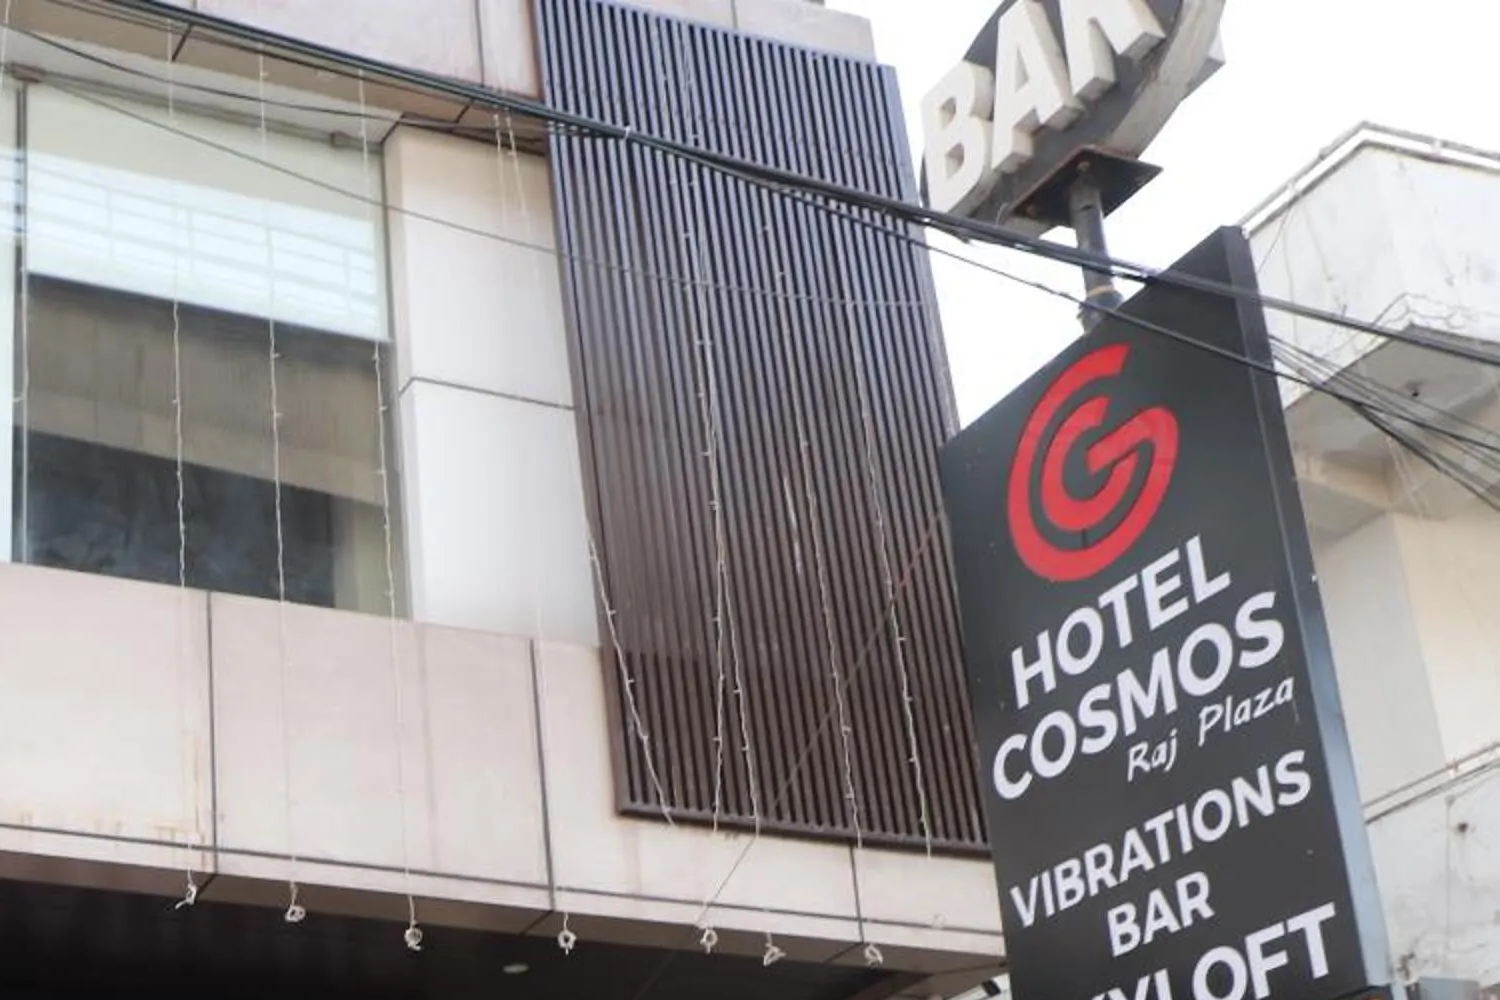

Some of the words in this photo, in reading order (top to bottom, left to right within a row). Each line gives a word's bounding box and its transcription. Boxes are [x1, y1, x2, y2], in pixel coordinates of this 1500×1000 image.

[993, 591, 1285, 799] COSMOS
[1011, 535, 1231, 709] HOTEL
[1126, 729, 1178, 781] Raj
[1198, 677, 1294, 747] Plaza
[1009, 750, 1312, 928] VIBRATIONS
[1107, 871, 1215, 956] BAR
